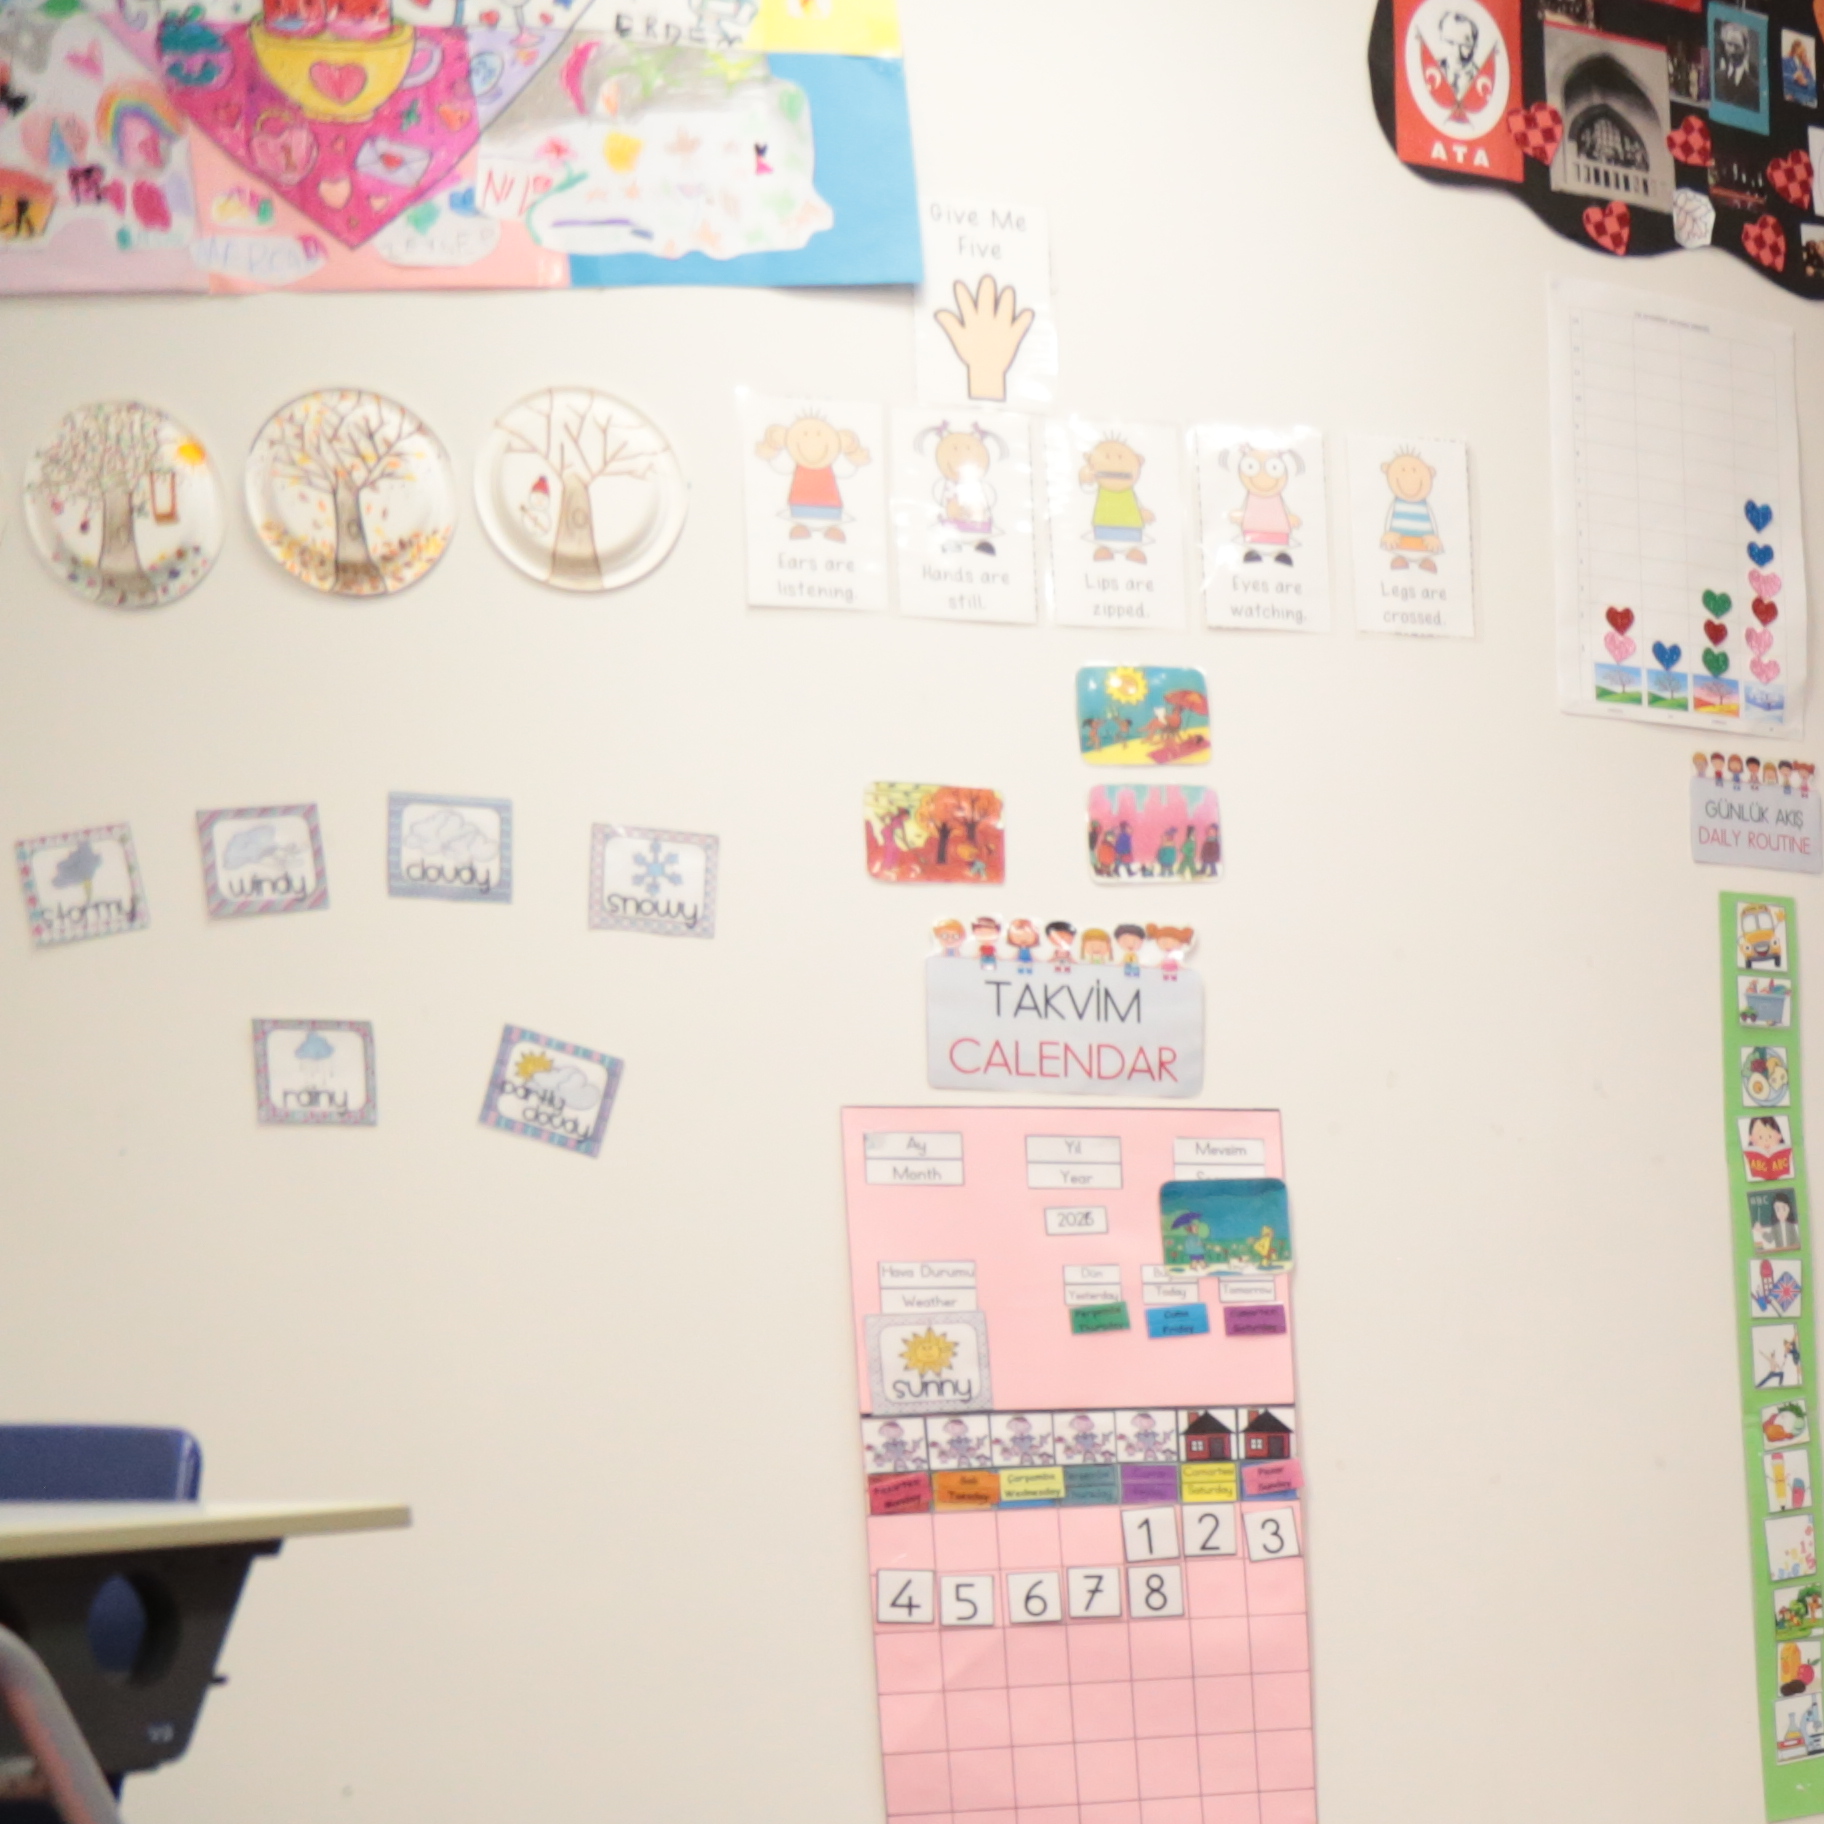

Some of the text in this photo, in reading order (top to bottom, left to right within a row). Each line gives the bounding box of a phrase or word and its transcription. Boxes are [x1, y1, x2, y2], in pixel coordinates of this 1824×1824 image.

[1431, 141, 1489, 168] ATA
[931, 202, 1026, 231] Give Me
[958, 235, 1002, 260] Five
[778, 554, 854, 575] Ears are
[922, 565, 1010, 586] Hands are
[778, 580, 857, 603] listening.
[1085, 573, 1154, 596] Lips are
[1232, 574, 1303, 597] Eyes are
[1380, 581, 1447, 604] Legs are
[1092, 600, 1149, 622] zipped.
[1230, 602, 1307, 625] watching.
[1383, 608, 1447, 627] crossed.
[1705, 798, 1804, 830] GÜNLÜK AKIŞ
[1698, 825, 1812, 855] DAILY ROUTINE
[228, 870, 309, 902] windy
[405, 860, 493, 893] cloudy
[41, 895, 138, 928] stormy
[606, 893, 699, 928] snowy
[985, 979, 1143, 1025] TAKVİM
[949, 1037, 1178, 1083] CALENDAR
[282, 1083, 350, 1118] rainy
[500, 1079, 566, 1117] partly
[521, 1104, 594, 1142] cloudy
[906, 1136, 927, 1156] Ay
[893, 1165, 942, 1181] Month
[1060, 1170, 1093, 1184] Year
[920, 1264, 976, 1278] Durumu
[901, 1295, 957, 1308] Weather
[893, 1377, 972, 1402] sunny
[1137, 1513, 1285, 1555] 1 2 3
[890, 1573, 1168, 1620] 4 5 6 7 8
